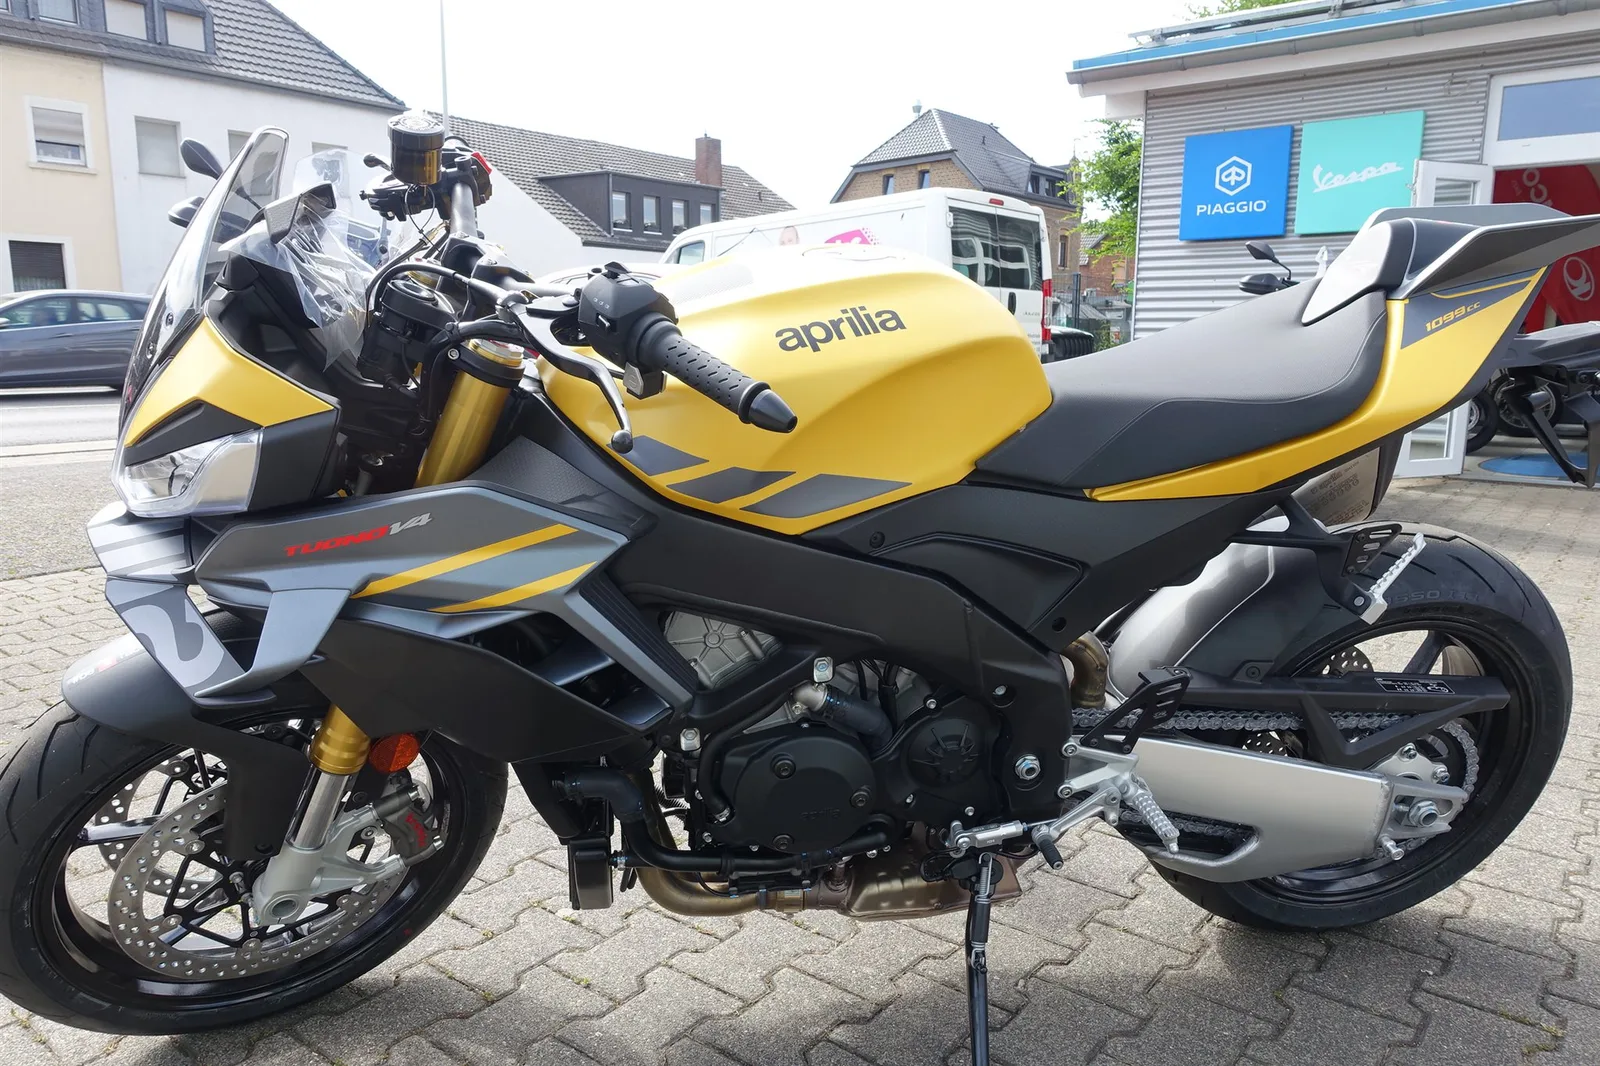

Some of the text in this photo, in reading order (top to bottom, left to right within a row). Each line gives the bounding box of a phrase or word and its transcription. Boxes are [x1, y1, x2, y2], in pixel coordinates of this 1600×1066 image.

[1312, 162, 1404, 193] Vespa
[1196, 200, 1267, 216] PIAGGIO
[775, 305, 907, 353] aprilia
[285, 524, 390, 557] TUONO
